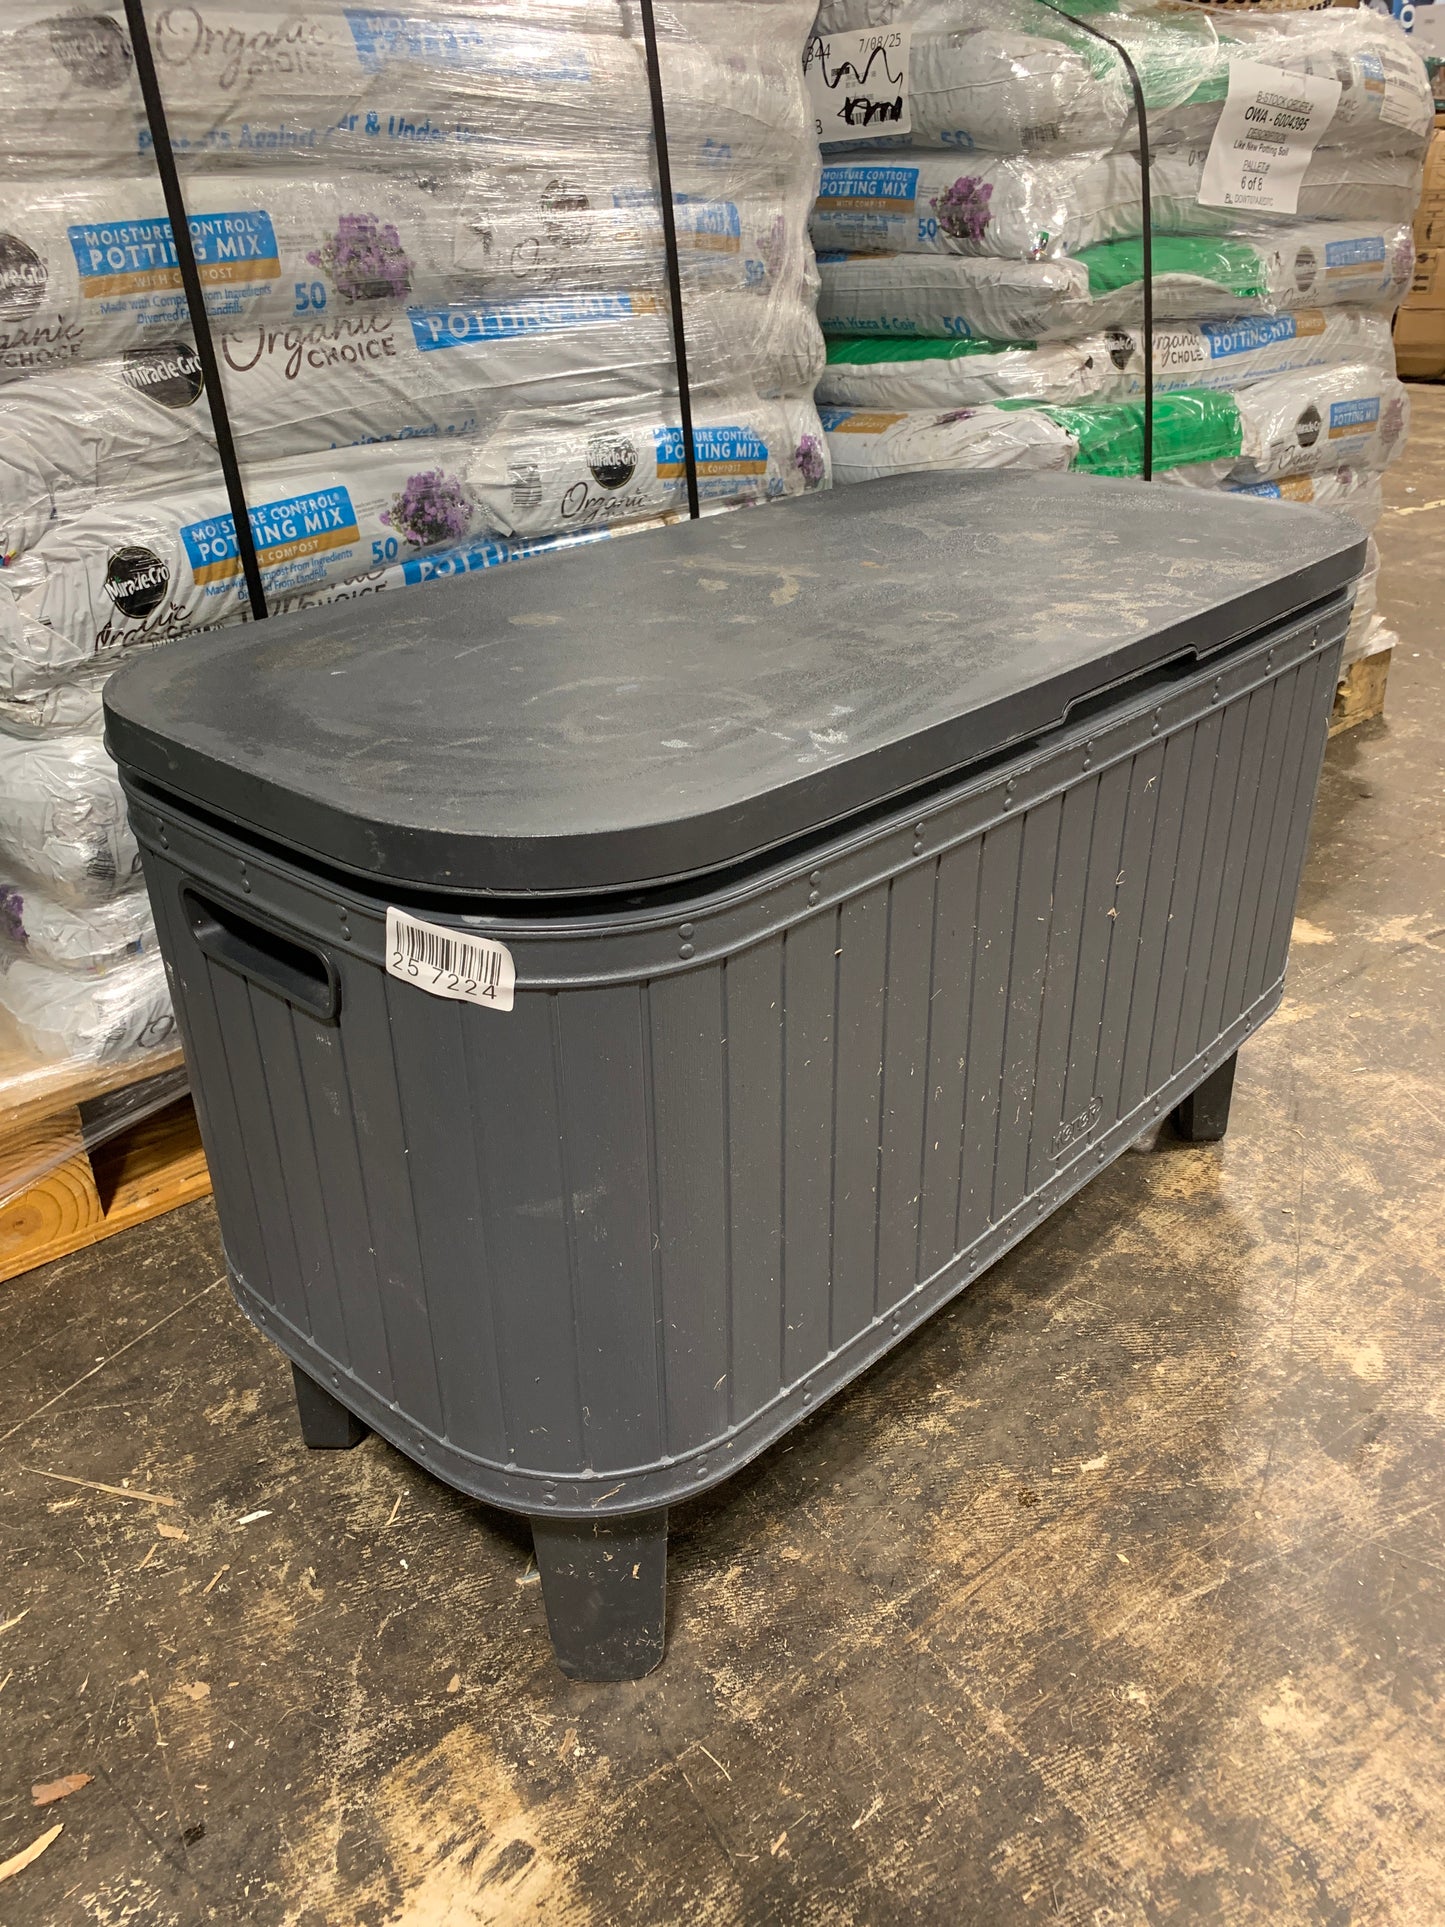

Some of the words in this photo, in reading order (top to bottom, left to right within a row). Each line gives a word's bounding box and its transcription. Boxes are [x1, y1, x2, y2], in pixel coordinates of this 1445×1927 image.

[1245, 107, 1268, 123] OWA
[820, 180, 878, 196] POTTING
[881, 181, 908, 197] MIX
[1241, 176, 1247, 190] 6
[1247, 177, 1257, 191] of
[1257, 178, 1264, 191] 8
[84, 223, 173, 247] MOISTURE
[918, 218, 937, 239] 50
[216, 234, 263, 259] MIX
[294, 280, 328, 312] 50
[943, 316, 972, 337] 50
[221, 313, 393, 380] Organic
[307, 334, 397, 369] CHOICE
[1213, 327, 1269, 355] POTTING
[664, 441, 731, 461] POTING
[735, 442, 760, 458] MIX
[198, 518, 298, 563] POTING
[303, 506, 344, 534] MIX
[267, 540, 320, 562] COMPOST
[371, 536, 398, 566] 50
